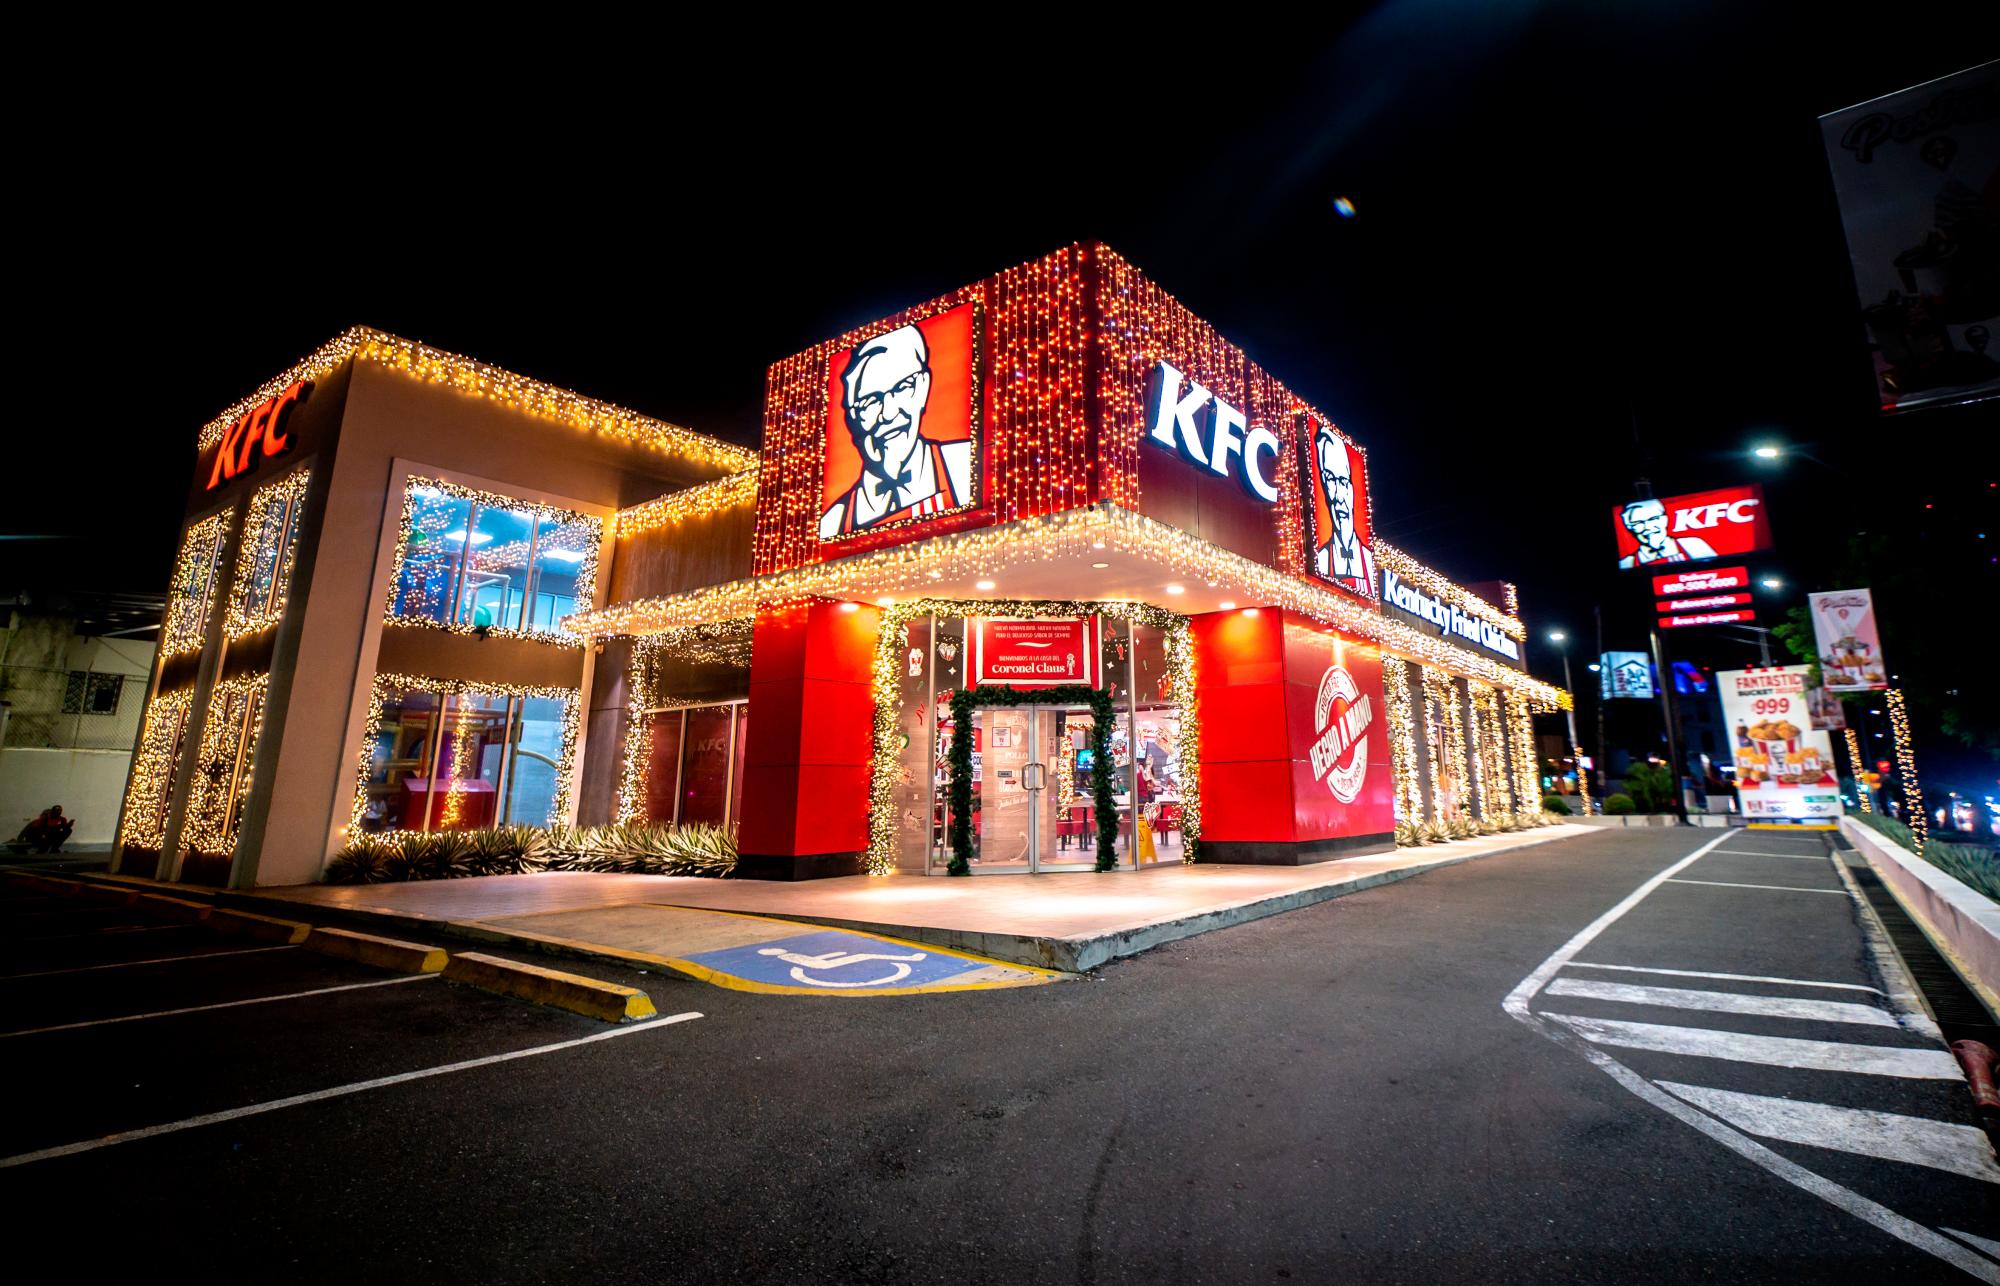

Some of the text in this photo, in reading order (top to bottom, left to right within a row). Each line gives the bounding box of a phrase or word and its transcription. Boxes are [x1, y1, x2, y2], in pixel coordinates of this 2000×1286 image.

[206, 381, 305, 491] KFC
[1152, 360, 1279, 503] KFC
[1672, 499, 1759, 532] KFC
[1384, 568, 1520, 661] Kentucky Fried Chicken
[991, 662, 1066, 674] Coronel Claus
[1338, 716, 1351, 751] A
[1344, 693, 1373, 743] MANO
[1309, 724, 1342, 782] HECHO
